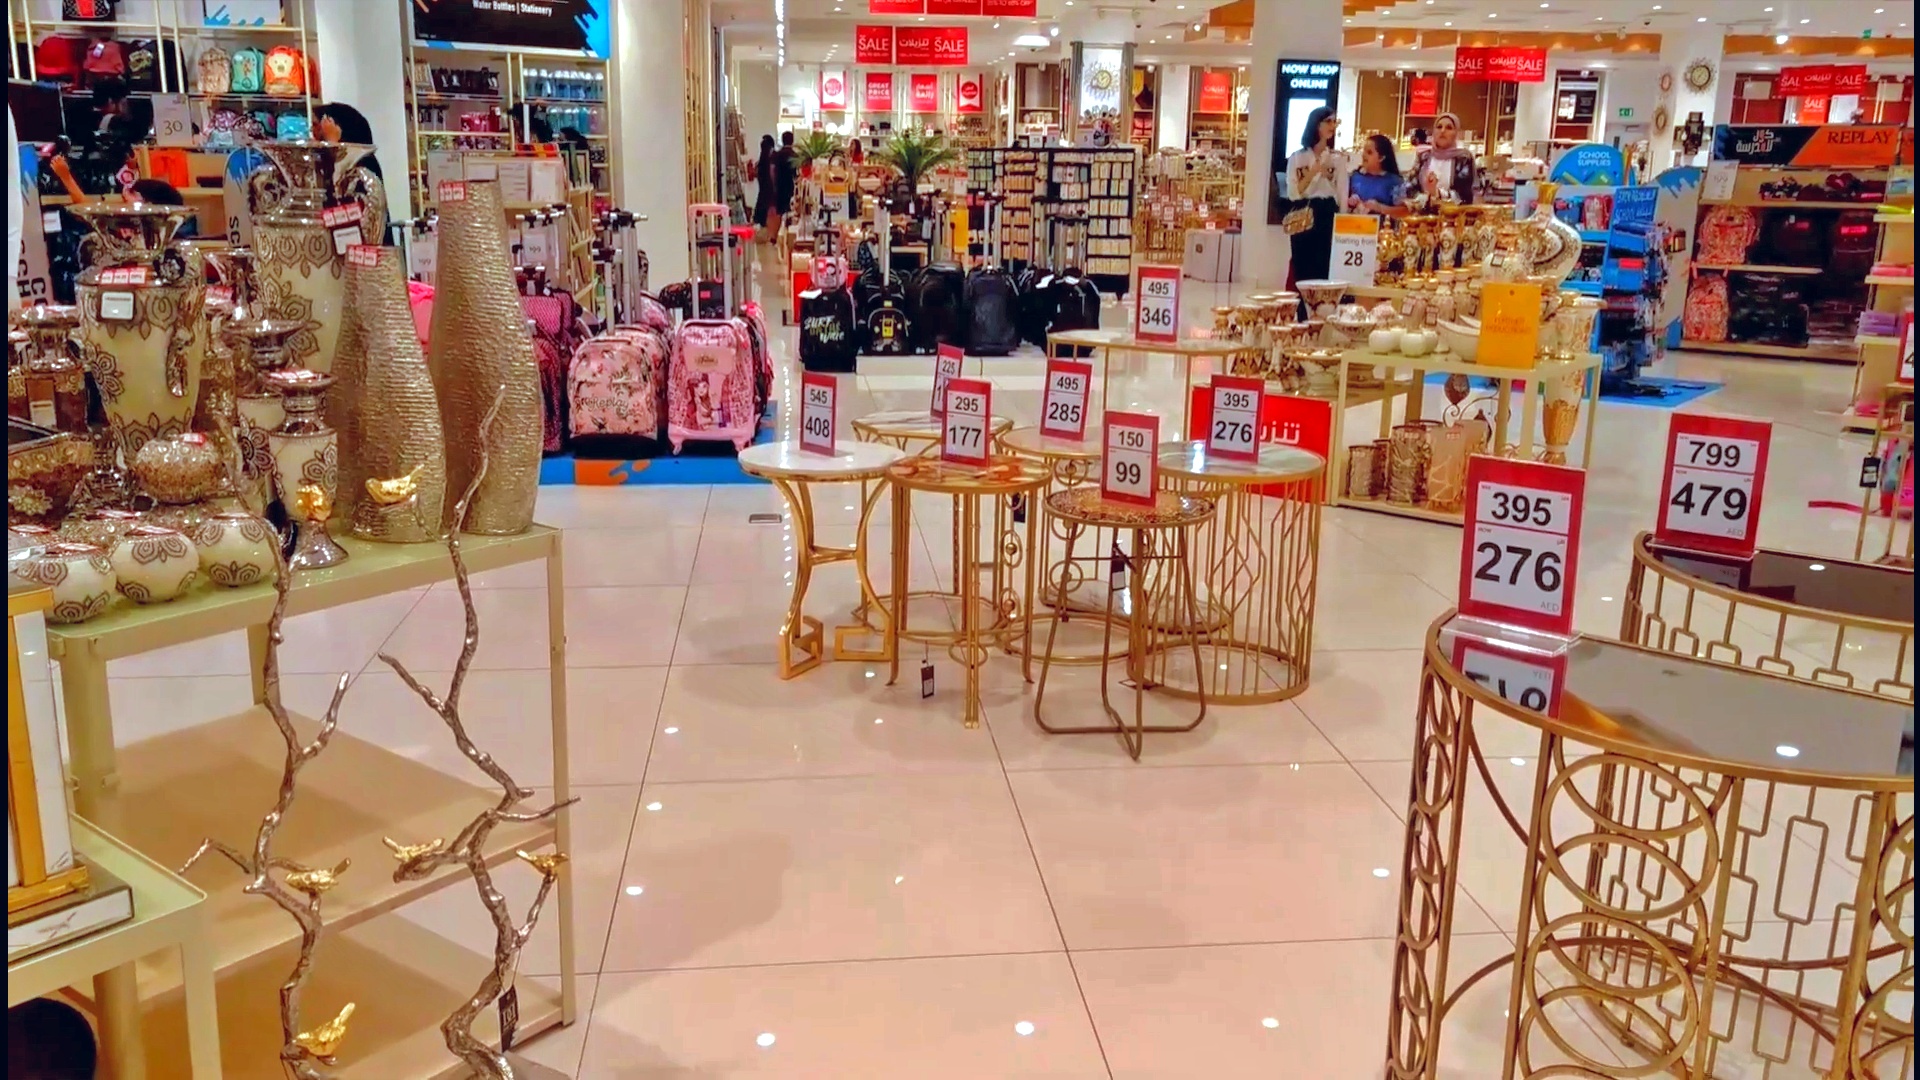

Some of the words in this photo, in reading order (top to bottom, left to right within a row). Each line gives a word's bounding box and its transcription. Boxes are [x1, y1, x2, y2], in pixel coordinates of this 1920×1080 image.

[472, 0, 491, 9] Water
[493, 1, 516, 12] Bottles
[520, 3, 553, 17] Stationery
[858, 38, 889, 51] SALE
[934, 39, 965, 53] SALE
[1281, 63, 1309, 75] NOW
[1310, 64, 1339, 76] SHOP
[1457, 58, 1483, 70] SALE
[1517, 59, 1543, 71] SALE
[1290, 78, 1328, 89] ONLINE
[1781, 75, 1801, 87] SAL
[1834, 73, 1862, 86] SALE
[1803, 97, 1825, 109] SALE
[163, 120, 183, 136] 30
[1827, 130, 1893, 145] REPLAY
[1578, 150, 1612, 159] SCHOOL
[1577, 159, 1611, 167] SUPPLIES
[229, 216, 242, 249] SC
[1343, 250, 1363, 267] 28
[1148, 281, 1169, 295] 495
[1142, 306, 1172, 327] 346
[942, 360, 956, 375] 225
[1056, 375, 1079, 391] 495
[810, 388, 828, 405] 545
[955, 396, 979, 412] 295
[1223, 392, 1250, 408] 395
[1048, 402, 1080, 423] 285
[805, 415, 830, 438] 408
[1214, 420, 1252, 443] 276
[949, 425, 982, 448] 177
[1118, 430, 1144, 448] 150
[1689, 440, 1741, 468] 799
[1115, 461, 1141, 485] 99
[1491, 492, 1552, 526] 395
[1671, 482, 1748, 521] 479
[1726, 527, 1745, 536] AED
[1475, 541, 1562, 593] 276
[1540, 601, 1560, 613] AED
